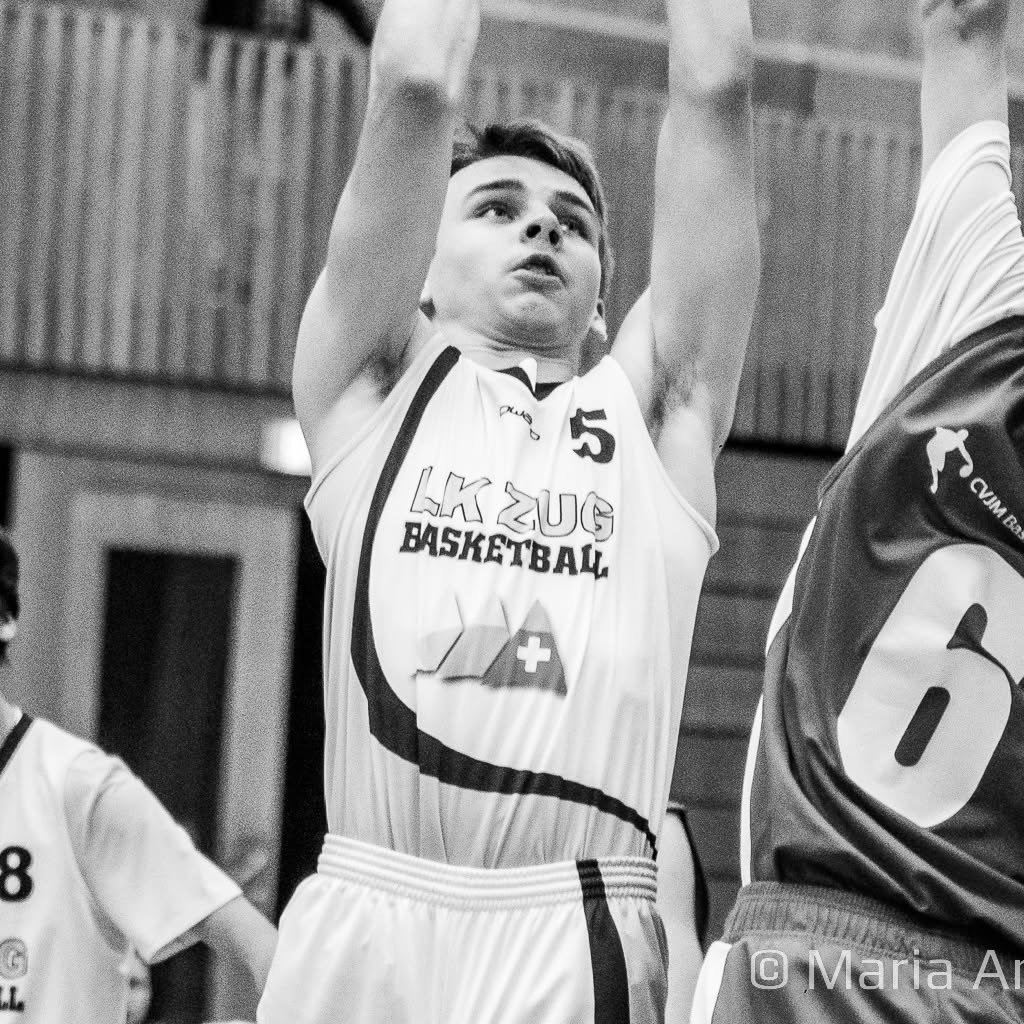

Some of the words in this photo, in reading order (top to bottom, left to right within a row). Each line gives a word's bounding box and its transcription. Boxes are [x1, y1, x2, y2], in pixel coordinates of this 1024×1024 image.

[569, 407, 616, 464] 5
[409, 465, 493, 523] LK
[497, 481, 615, 542] ZUG
[969, 477, 1008, 518] CVJM
[399, 520, 609, 581] BASKETBALL
[0, 845, 34, 902] 8
